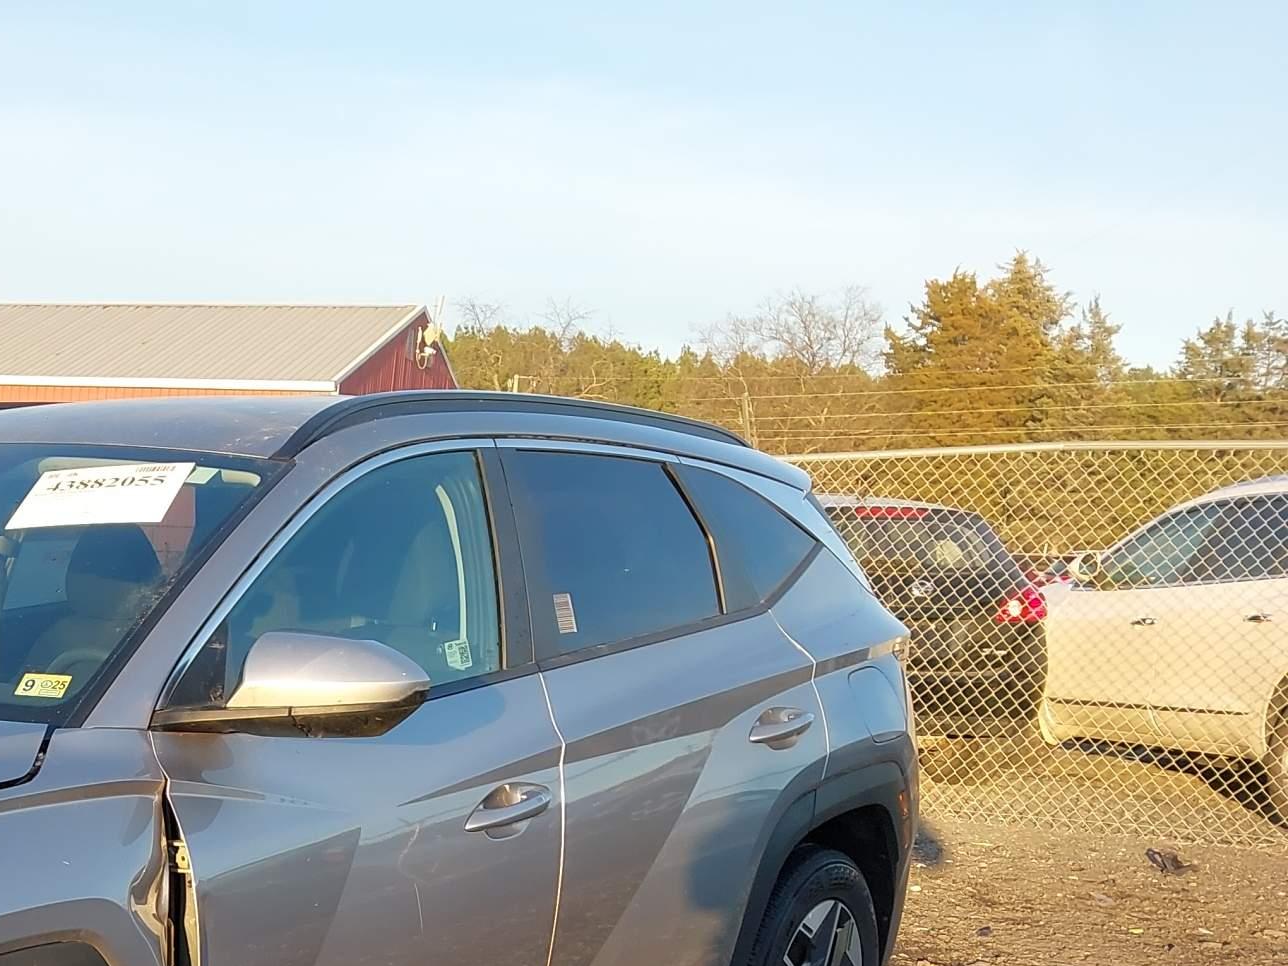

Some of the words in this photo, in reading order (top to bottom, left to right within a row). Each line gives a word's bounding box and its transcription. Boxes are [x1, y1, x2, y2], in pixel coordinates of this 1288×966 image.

[47, 475, 167, 492] 43882055
[23, 679, 35, 691] 9
[52, 680, 66, 690] 25
